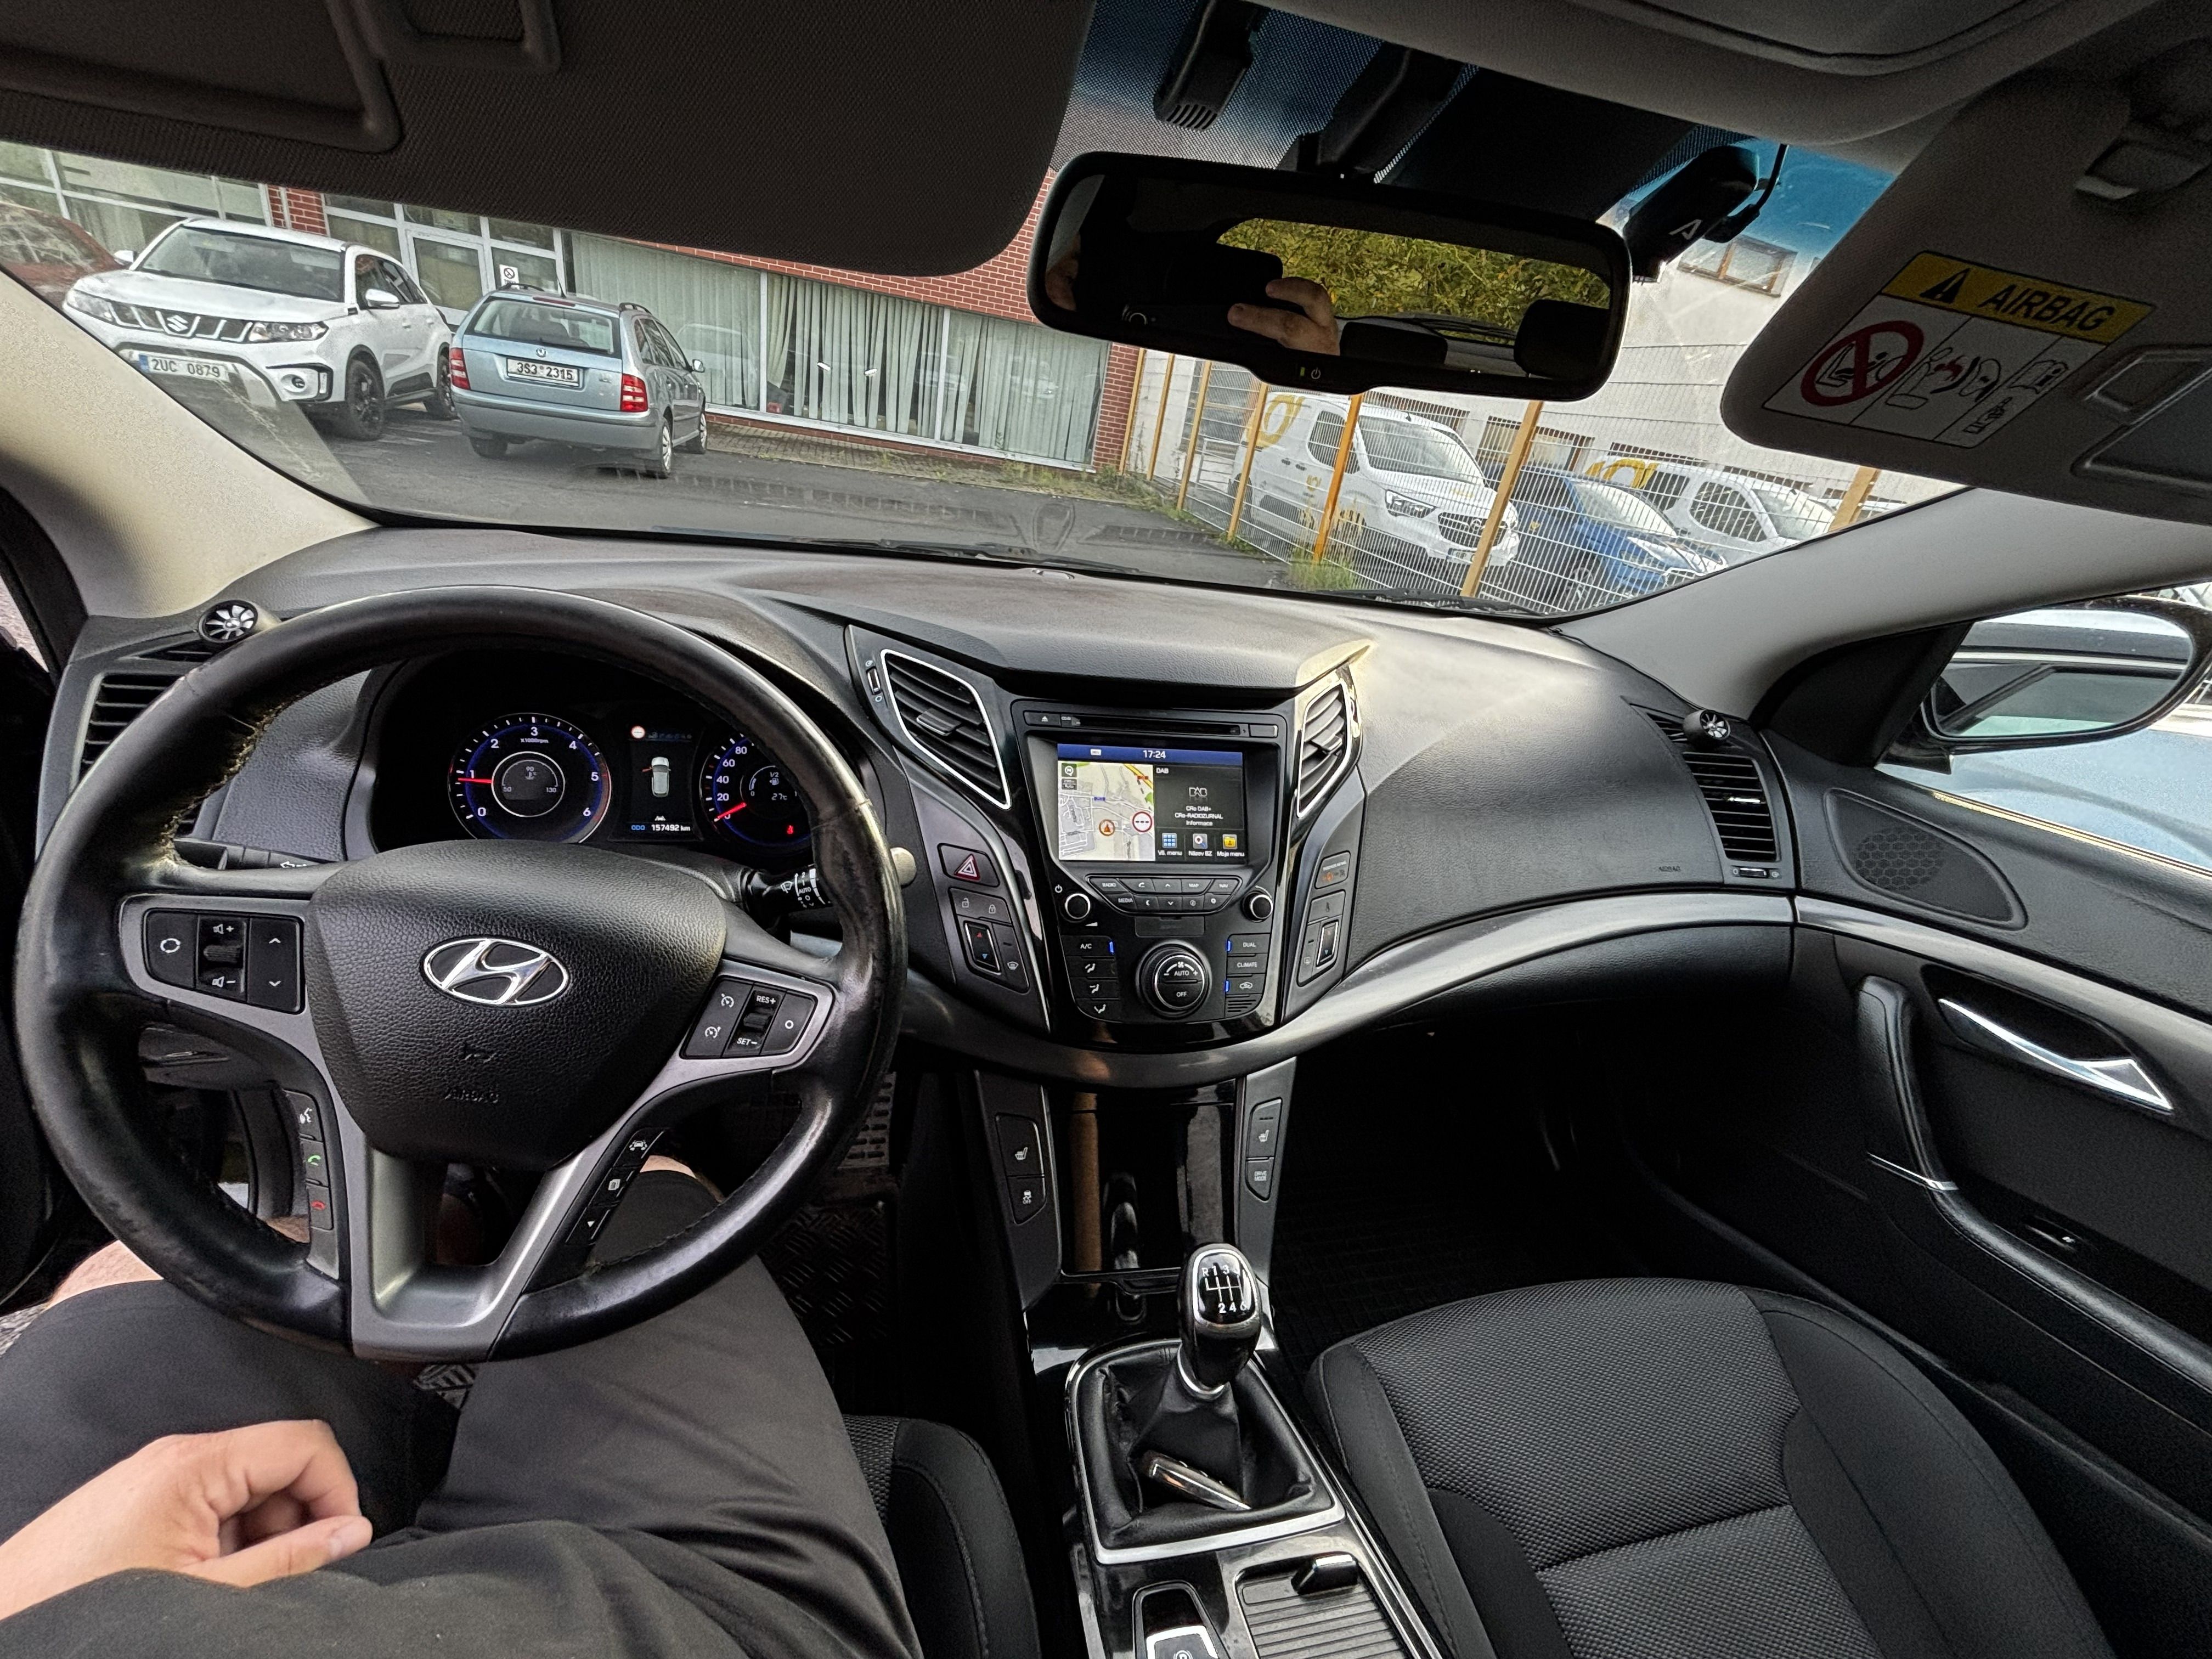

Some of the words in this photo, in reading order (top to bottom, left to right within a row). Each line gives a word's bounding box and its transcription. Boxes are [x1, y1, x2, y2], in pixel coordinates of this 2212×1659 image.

[1977, 284, 2115, 331] AIRBAG
[152, 359, 177, 373] 2UC
[188, 364, 220, 377] 0879
[517, 363, 537, 375] 3S3
[546, 367, 573, 380] 2315
[531, 726, 538, 736] 3
[490, 739, 499, 748] 2
[569, 741, 577, 749] 4
[735, 746, 747, 754] 80
[1143, 750, 1166, 759] 17:24
[470, 770, 475, 778] 1
[591, 772, 599, 781] 5
[716, 775, 729, 783] 40
[717, 793, 729, 801] 20
[478, 808, 486, 816] 0
[583, 808, 591, 816] 6
[1201, 1267, 1209, 1277] R
[1211, 1265, 1217, 1276] 1
[1222, 1265, 1229, 1275] 3
[1218, 1302, 1227, 1313] 2
[1229, 1302, 1237, 1312] 4
